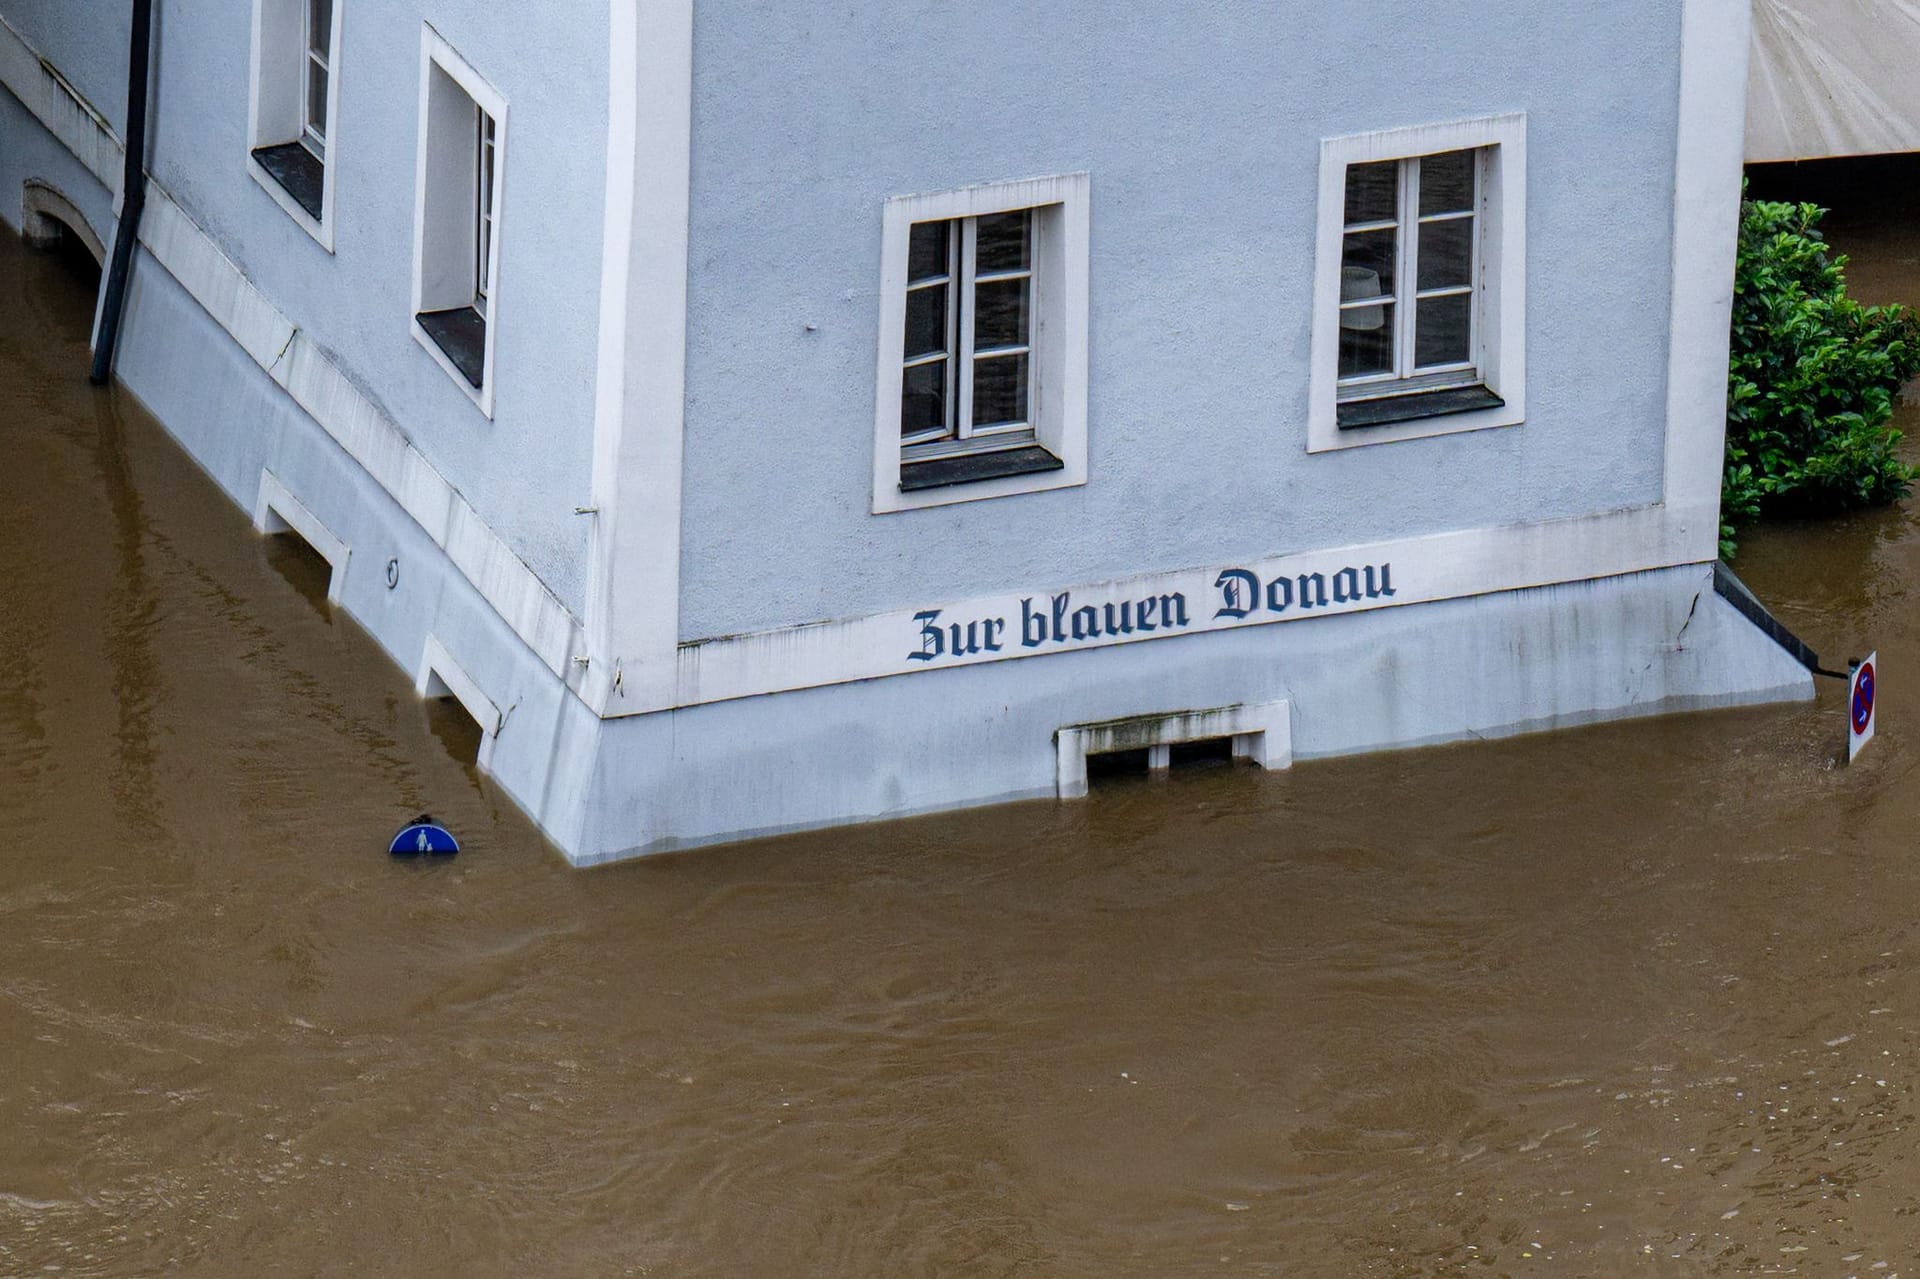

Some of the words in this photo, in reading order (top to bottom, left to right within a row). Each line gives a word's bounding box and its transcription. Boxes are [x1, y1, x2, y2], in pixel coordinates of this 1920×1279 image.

[907, 609, 1005, 662] Zur
[1020, 591, 1190, 648] blauen
[1213, 562, 1397, 619] Donau
